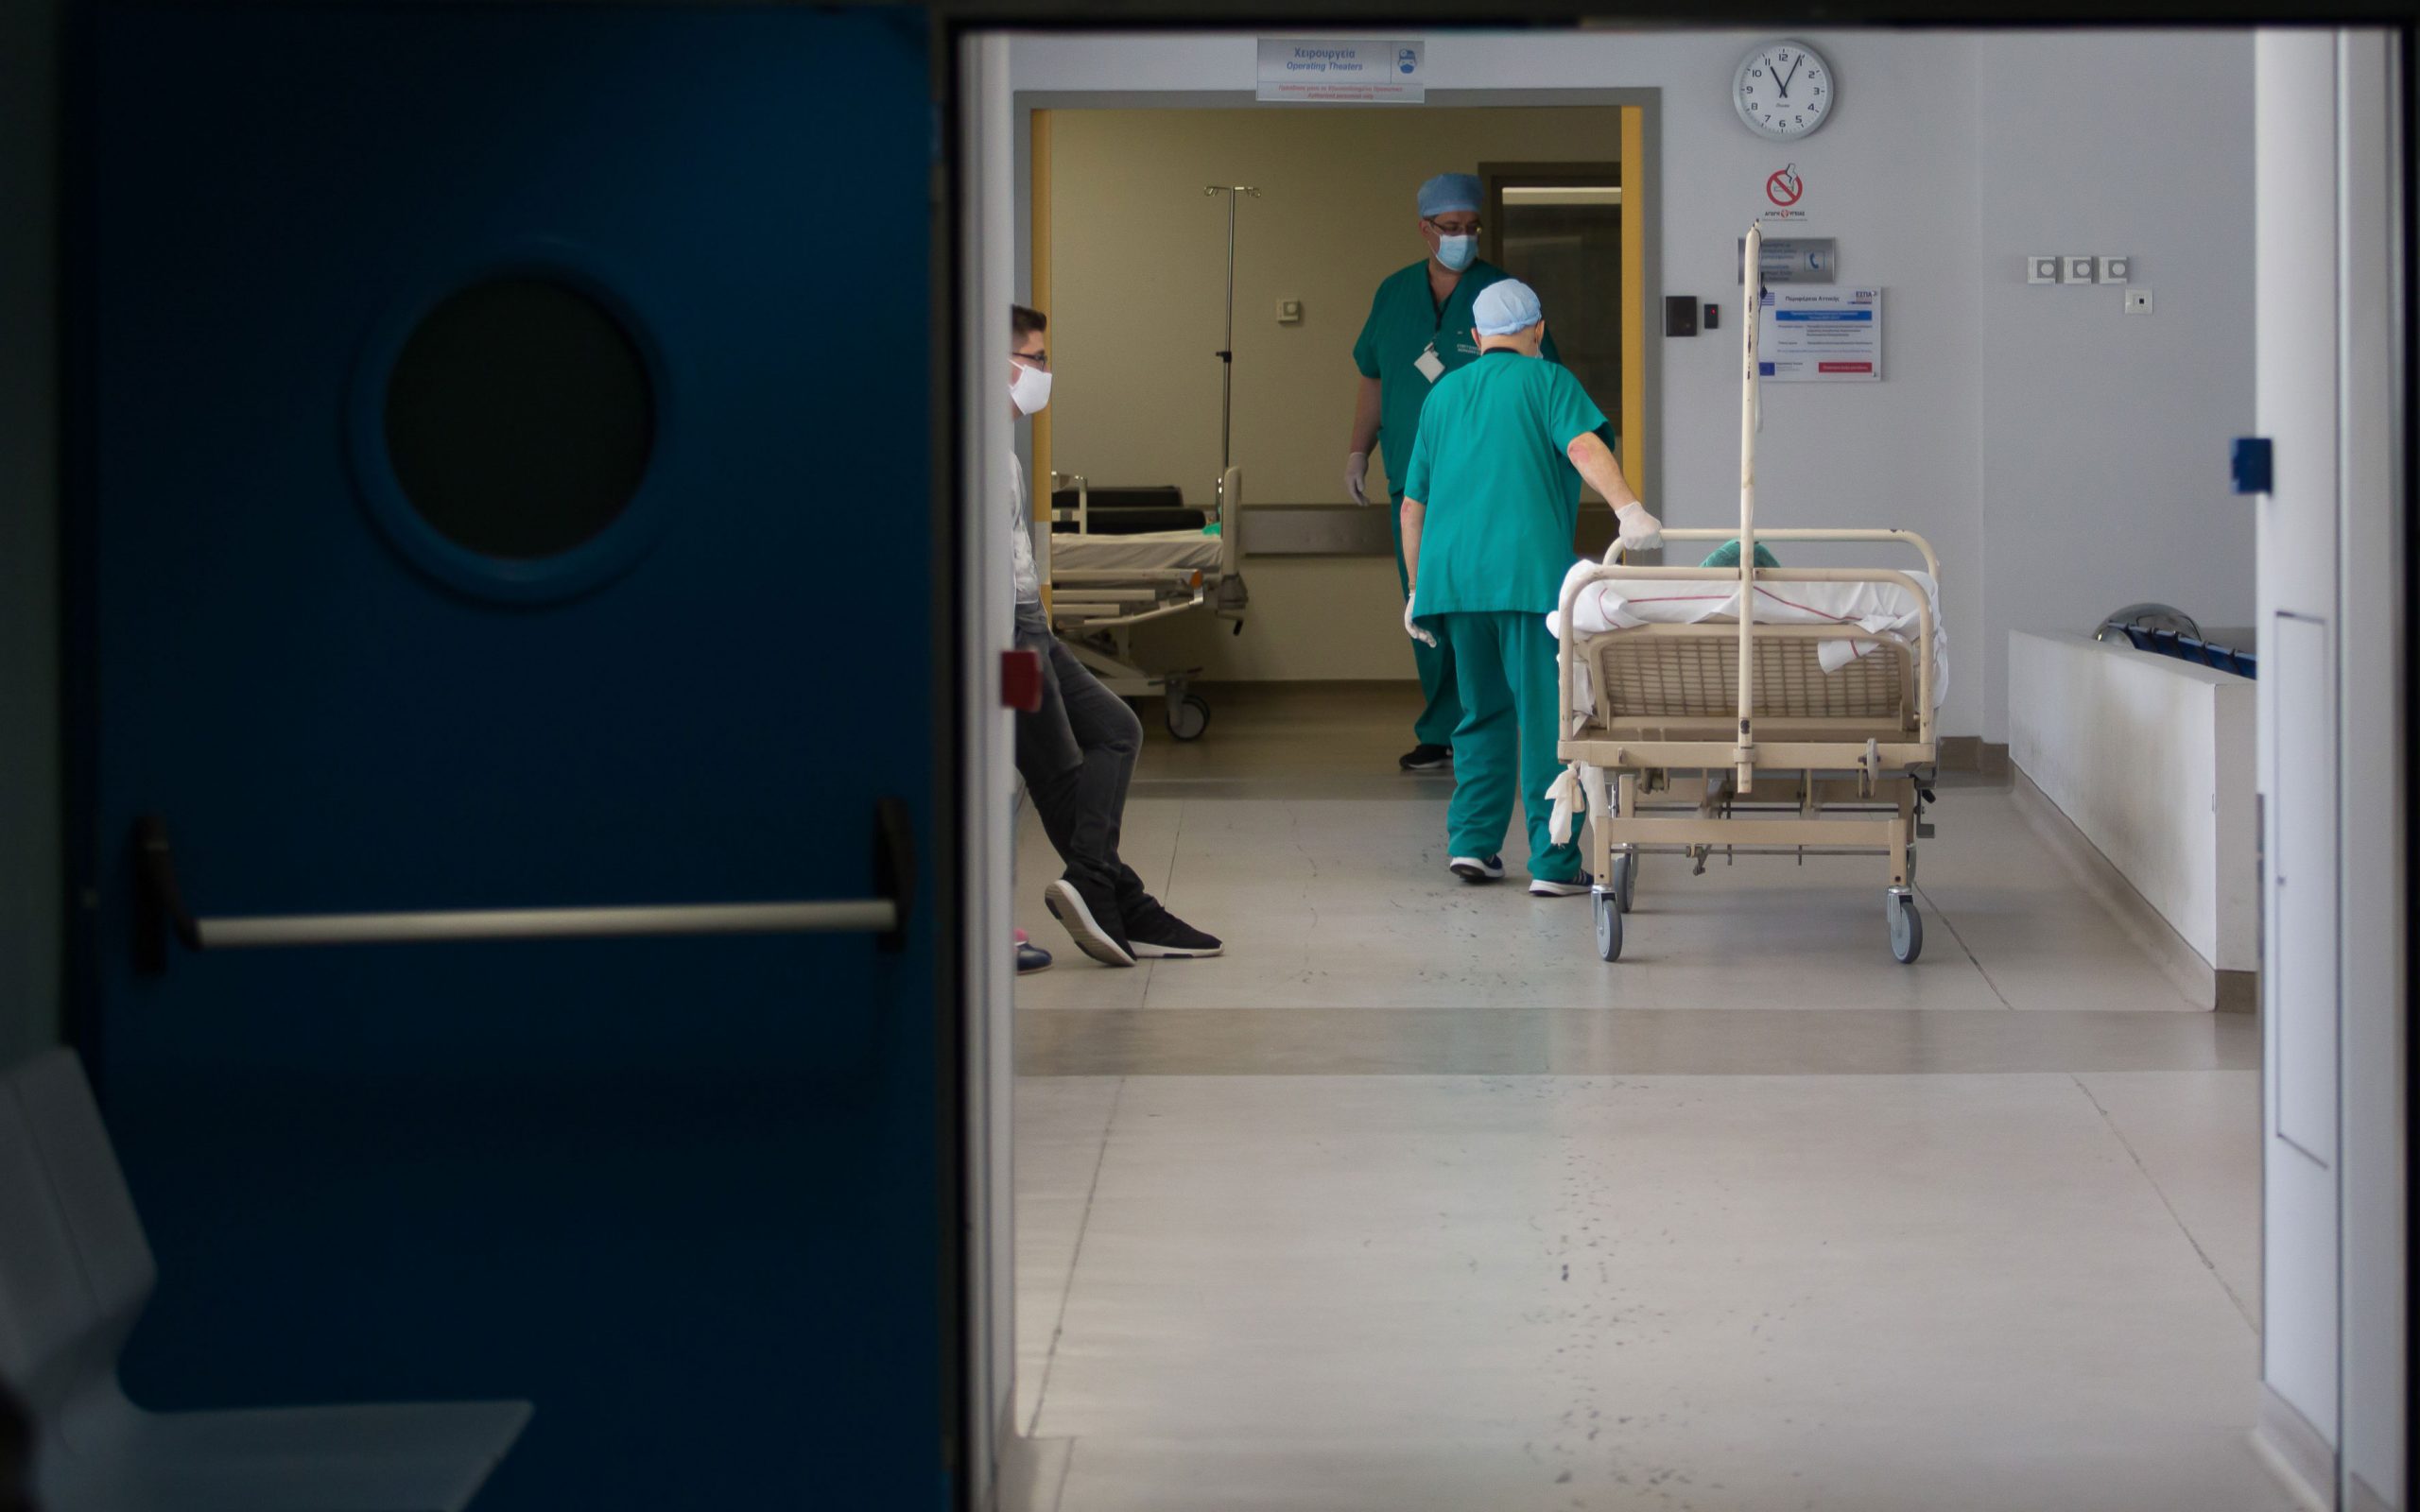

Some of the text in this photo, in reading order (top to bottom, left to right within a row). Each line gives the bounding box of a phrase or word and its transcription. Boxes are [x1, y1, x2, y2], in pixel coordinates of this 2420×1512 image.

[1294, 47, 1356, 60] Χειρουργεία
[1287, 61, 1363, 71] Operating Theaters
[1752, 69, 1762, 77] 10
[1813, 87, 1820, 95] 3
[1795, 115, 1803, 124] 5
